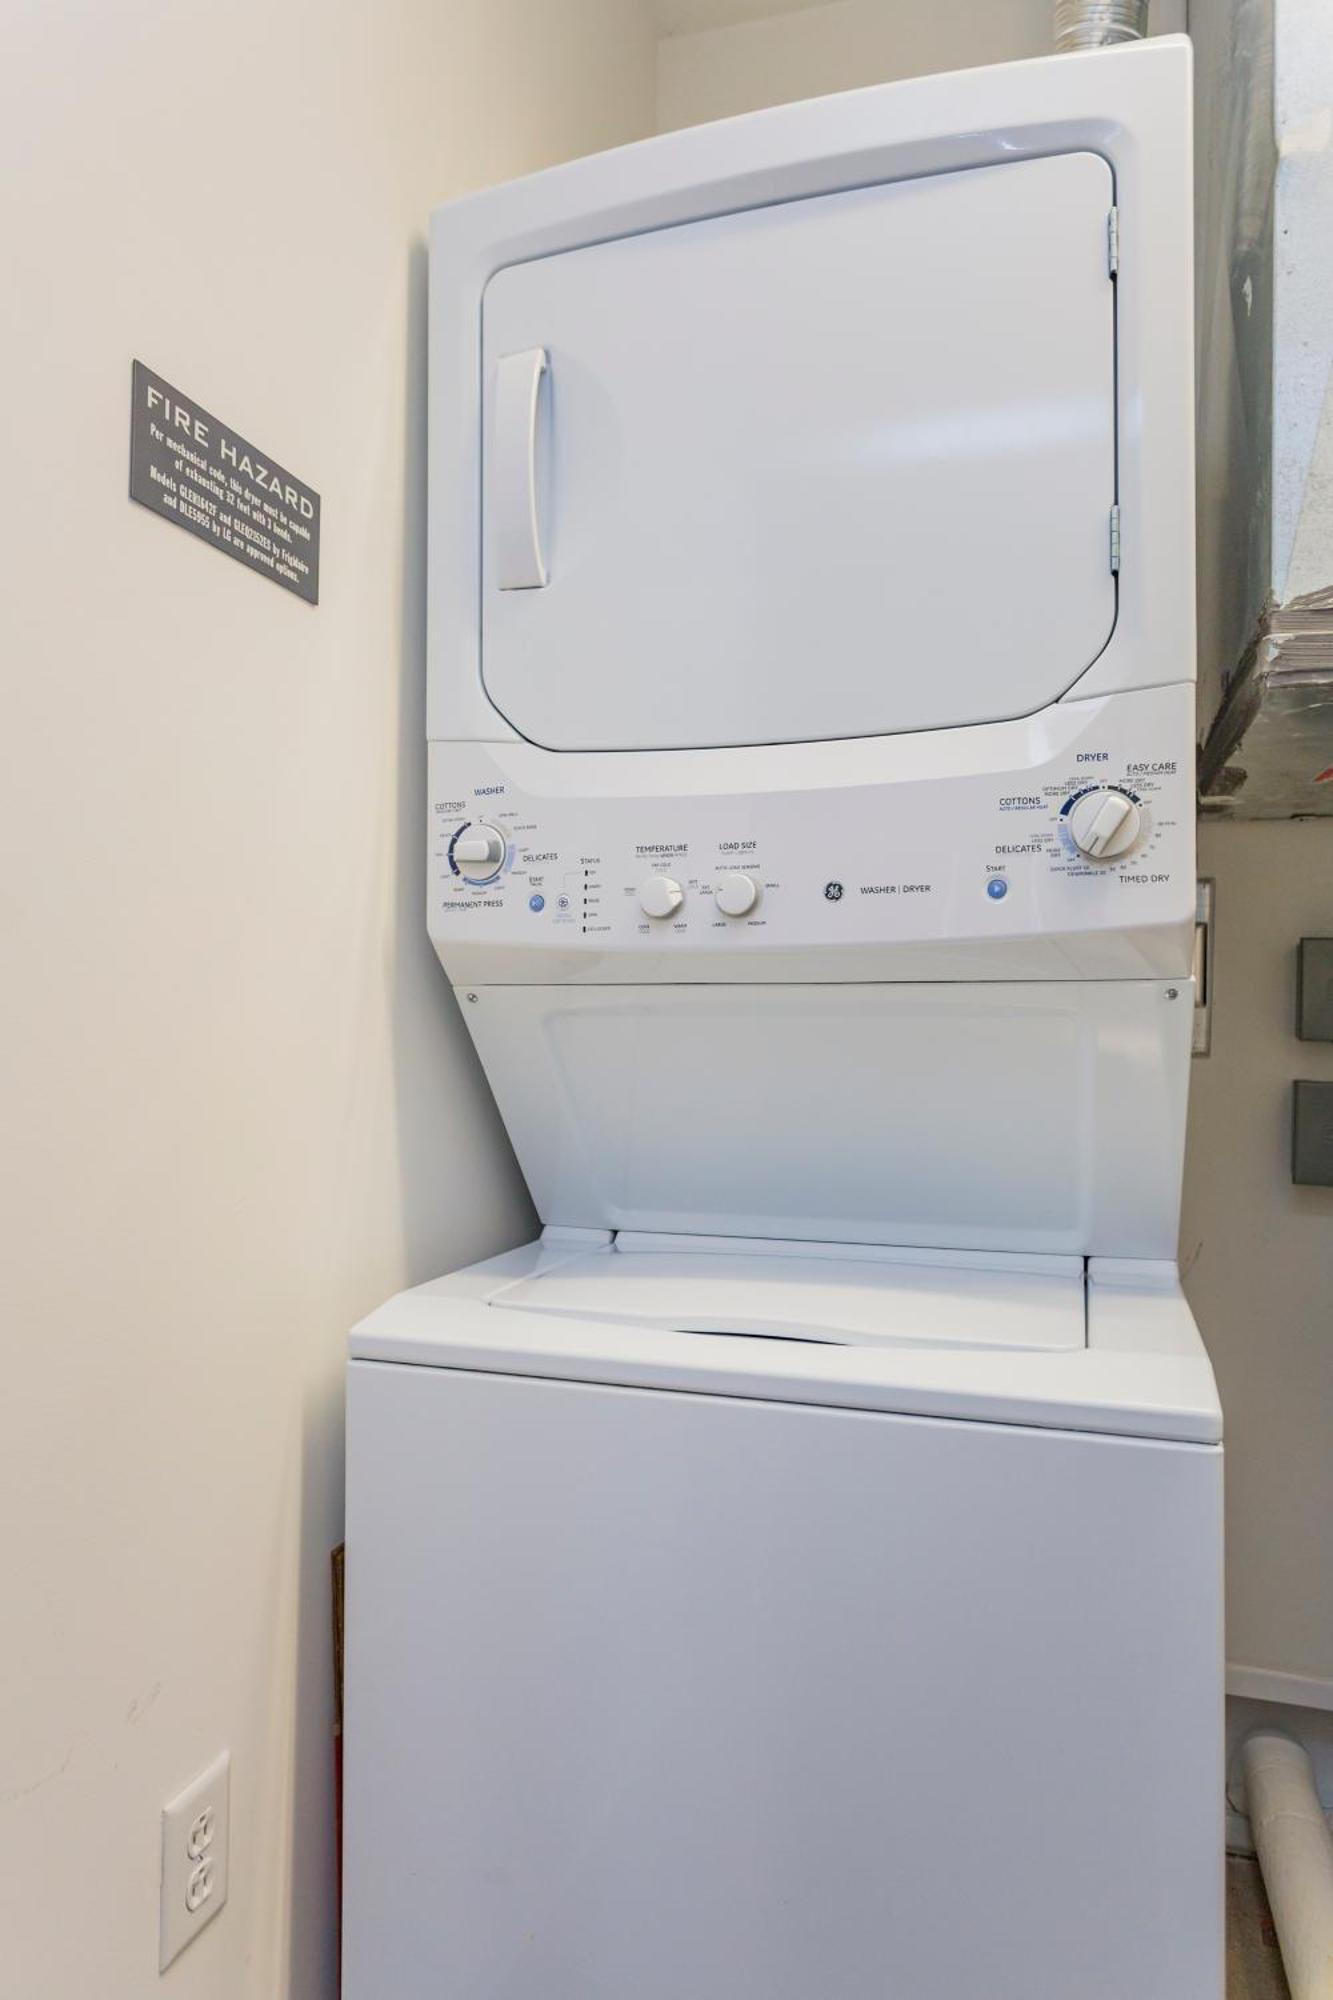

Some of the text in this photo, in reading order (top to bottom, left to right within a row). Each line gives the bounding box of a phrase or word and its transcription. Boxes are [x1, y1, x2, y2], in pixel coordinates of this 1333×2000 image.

[147, 385, 313, 522] FIRE HAZARD
[150, 422, 309, 542] Per mechanical code, this dryer must be capable
[174, 457, 183, 473] of
[184, 464, 223, 500] exhausting
[236, 498, 249, 516] feet
[252, 508, 265, 526] with
[273, 523, 292, 543] bends.
[150, 465, 176, 493] Models
[219, 509, 231, 526] and
[273, 543, 280, 558] by
[281, 549, 308, 575] Frigidaire
[163, 491, 176, 510] and
[212, 522, 220, 537] by
[223, 528, 231, 542] LG
[233, 535, 243, 550] are
[246, 543, 273, 569] approved
[276, 561, 299, 584] options.
[1076, 753, 1109, 763] DRYER
[1127, 762, 1177, 773] EASY CARE
[474, 787, 505, 796] WASHER
[435, 801, 466, 810] COTTONS
[999, 797, 1041, 806] COTTONS
[635, 844, 688, 853] TEMPERATURE
[719, 841, 757, 850] LOAD SIZE
[995, 845, 1042, 854] DELICATES
[522, 853, 558, 862] DELICATES
[1150, 874, 1169, 882] DRY
[860, 885, 931, 894] WASHER DRYER
[443, 900, 503, 909] PERMANENT PRESS
